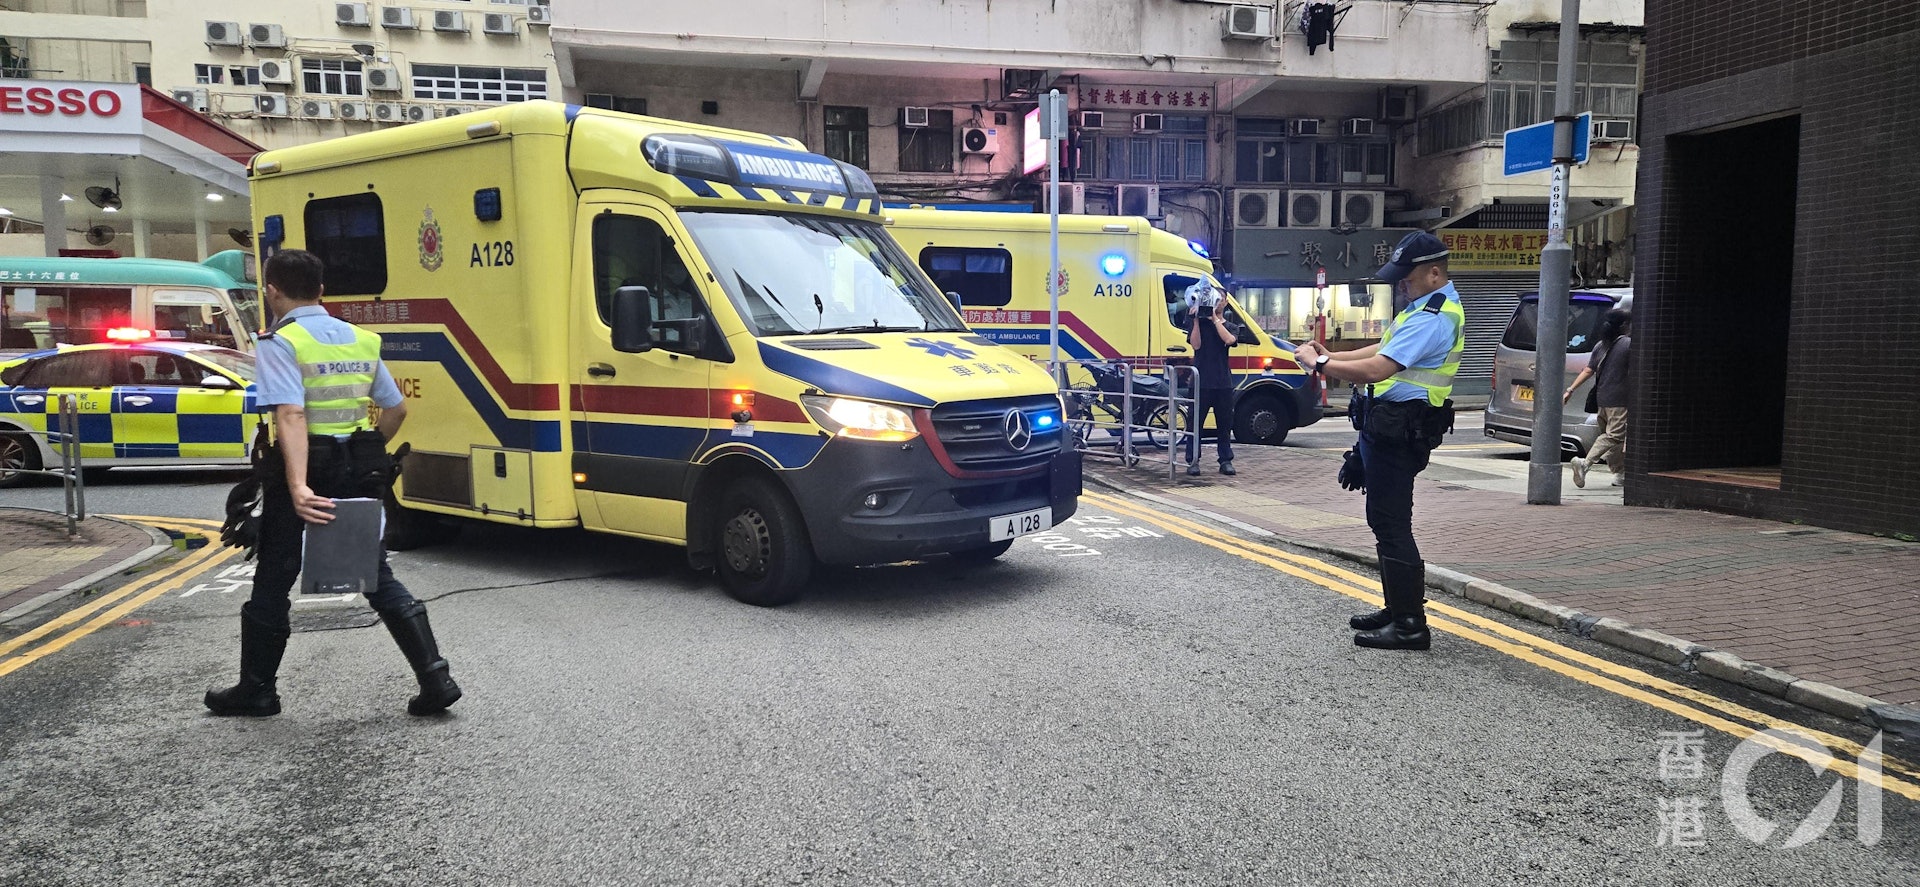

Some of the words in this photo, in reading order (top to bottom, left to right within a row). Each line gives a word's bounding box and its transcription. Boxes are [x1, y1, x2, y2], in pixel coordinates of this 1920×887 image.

[0, 87, 121, 116] ESSO
[735, 152, 843, 186] AMBULANCE
[470, 240, 514, 268] A128
[1093, 283, 1133, 297] A130
[381, 342, 422, 352] AMBULANCE
[329, 362, 361, 373] POLICE
[1007, 522, 1016, 537] A
[1020, 513, 1041, 534] 128
